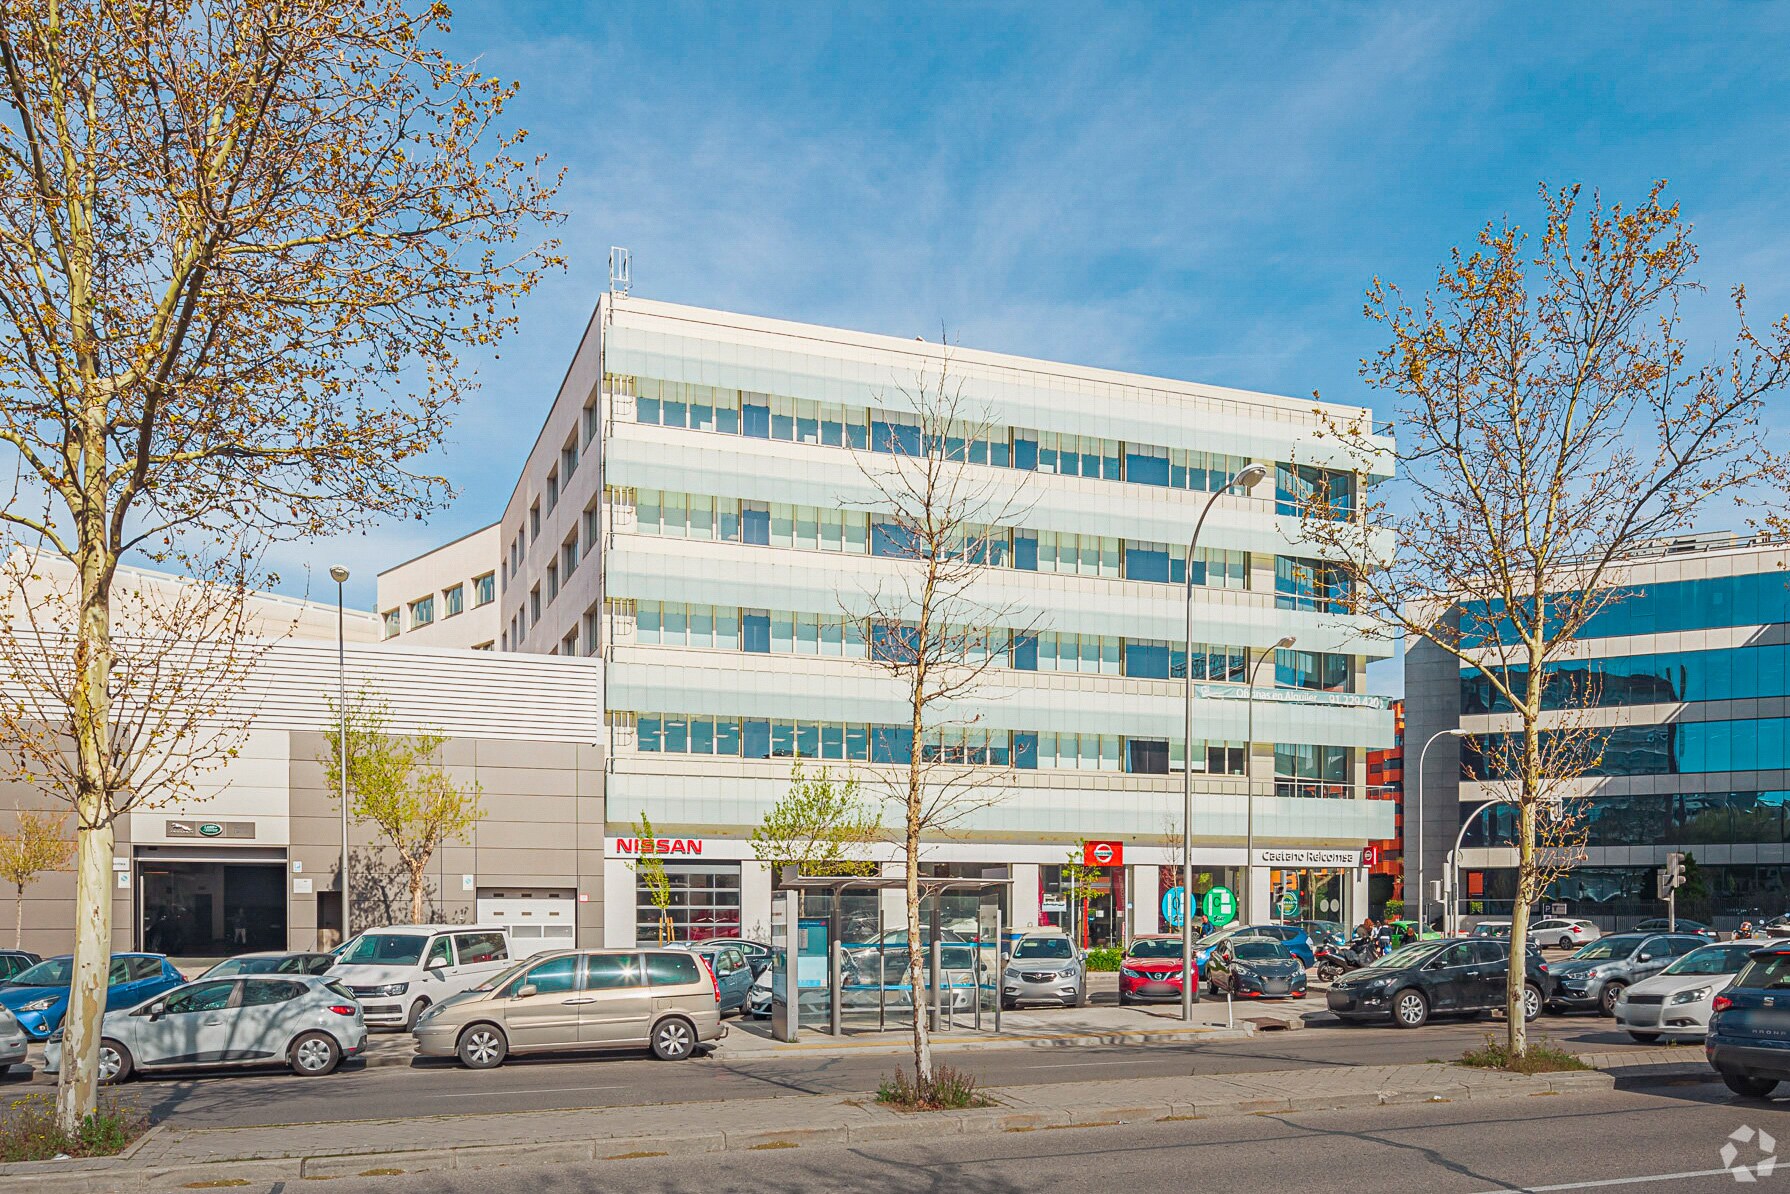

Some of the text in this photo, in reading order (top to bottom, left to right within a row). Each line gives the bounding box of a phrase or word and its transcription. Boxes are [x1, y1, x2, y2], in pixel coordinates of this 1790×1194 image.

[1236, 688, 1271, 699] Ofiinas
[1272, 691, 1283, 700] en
[1285, 690, 1317, 702] Alquiler
[1328, 694, 1340, 703] 91
[1342, 695, 1360, 705] 229
[616, 838, 702, 855] NISSAN
[1261, 850, 1305, 862] Caetano
